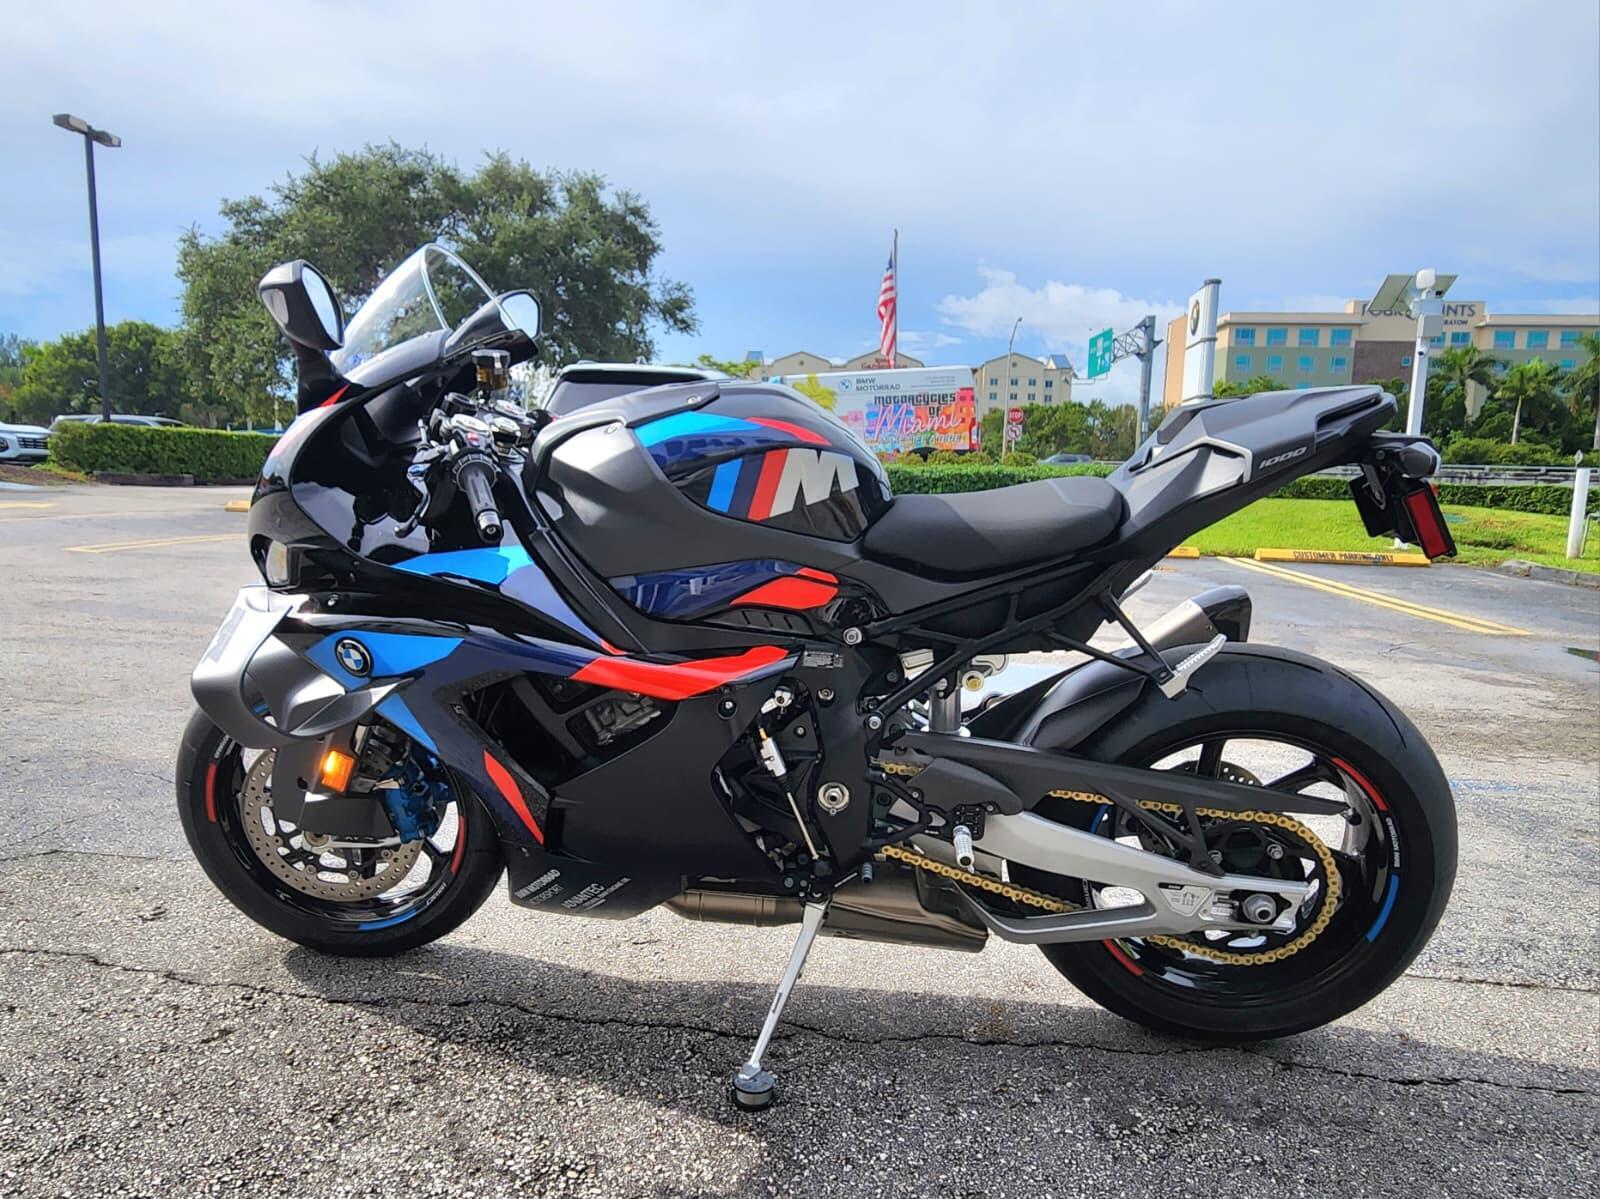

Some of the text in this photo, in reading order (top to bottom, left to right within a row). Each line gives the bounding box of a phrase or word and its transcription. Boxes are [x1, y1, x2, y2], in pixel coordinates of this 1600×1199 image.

[855, 384, 901, 392] MOTORRAD
[874, 403, 963, 441] Miami
[1009, 411, 1023, 420] STOP
[1258, 447, 1307, 469] 1000
[769, 448, 859, 517] M
[1293, 551, 1336, 561] CUSTOMER
[527, 869, 561, 893] MOTORRAD
